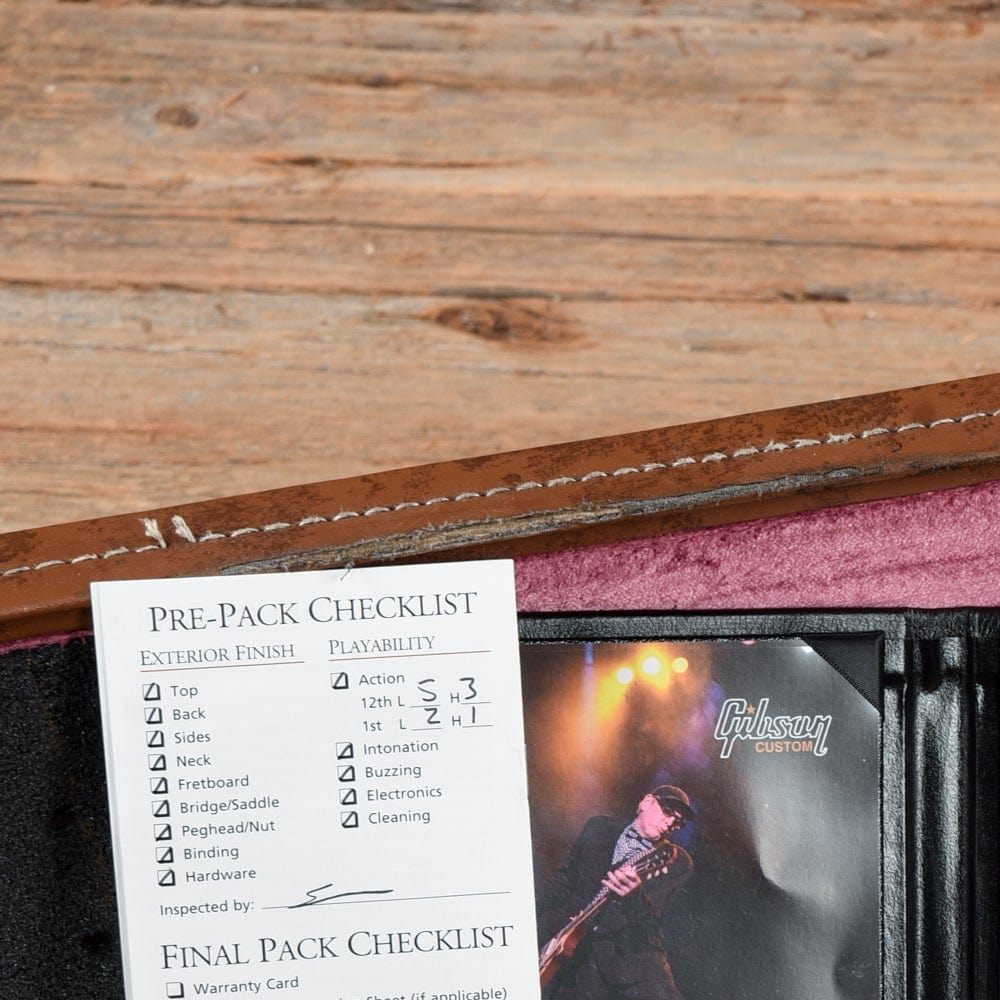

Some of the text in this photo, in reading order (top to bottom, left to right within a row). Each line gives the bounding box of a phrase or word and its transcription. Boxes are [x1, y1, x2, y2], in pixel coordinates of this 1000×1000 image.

[148, 592, 477, 632] PRE-PACK CHECKLIST
[329, 636, 435, 655] PLAYABILITY
[140, 644, 294, 666] EXTERIOR FINISH
[358, 672, 405, 686] Action
[170, 685, 198, 699] Top
[361, 695, 392, 709] 12th
[398, 696, 405, 707] L
[450, 692, 460, 704] H
[460, 677, 477, 700] 3
[172, 707, 206, 721] Back
[363, 720, 382, 732] 1st
[399, 718, 407, 730] L
[452, 715, 462, 727] H
[714, 697, 832, 759] Gibson
[174, 731, 211, 744] Sides
[363, 740, 439, 755] Intonation
[755, 740, 813, 753] CUSTOM
[176, 754, 211, 767] Neck
[365, 764, 421, 779] Buzzing
[178, 774, 249, 790] Fretboard
[367, 786, 442, 801] Electronics
[180, 796, 280, 815] Bridge/Saddle
[368, 810, 431, 824] Cleaning
[182, 820, 276, 839] Peghead/Nut
[184, 846, 239, 860] Binding
[186, 869, 256, 882] Hardware
[160, 899, 254, 917] Inspected by:
[161, 925, 514, 969] FINAL PACK CHECKLIST
[193, 976, 299, 995] Warranty Card
